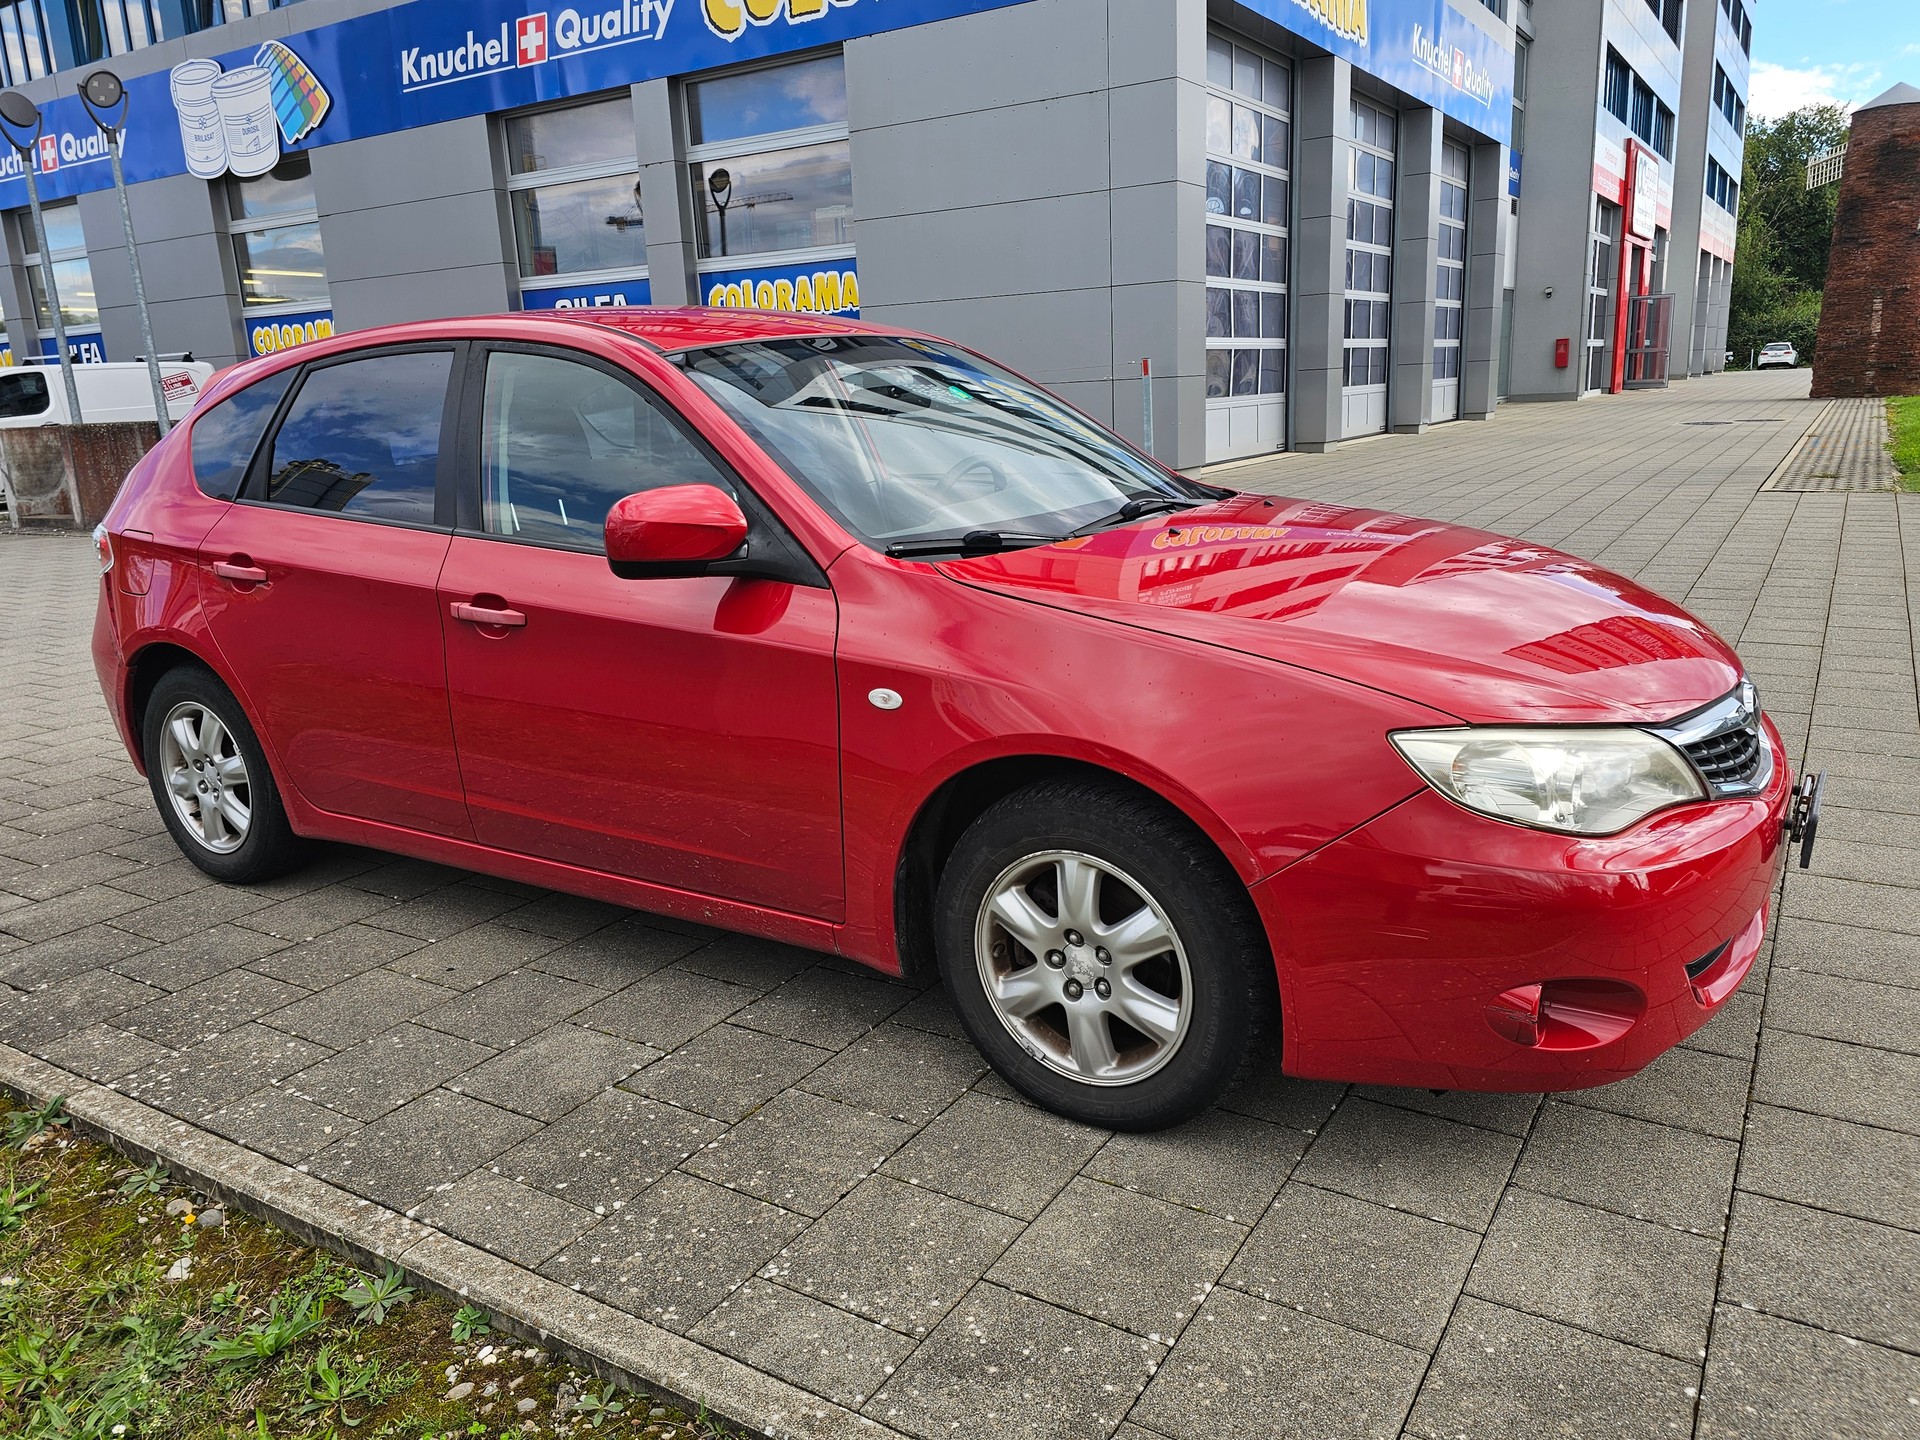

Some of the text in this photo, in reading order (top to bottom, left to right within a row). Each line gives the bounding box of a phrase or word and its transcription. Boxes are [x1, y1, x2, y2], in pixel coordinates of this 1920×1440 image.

[401, 22, 509, 85] Knuchel
[555, 0, 675, 49] Quality
[1412, 22, 1453, 77] Knuchel
[1464, 59, 1495, 110] Quality
[708, 271, 859, 315] COLORAMA
[252, 318, 335, 355] COLORAM
